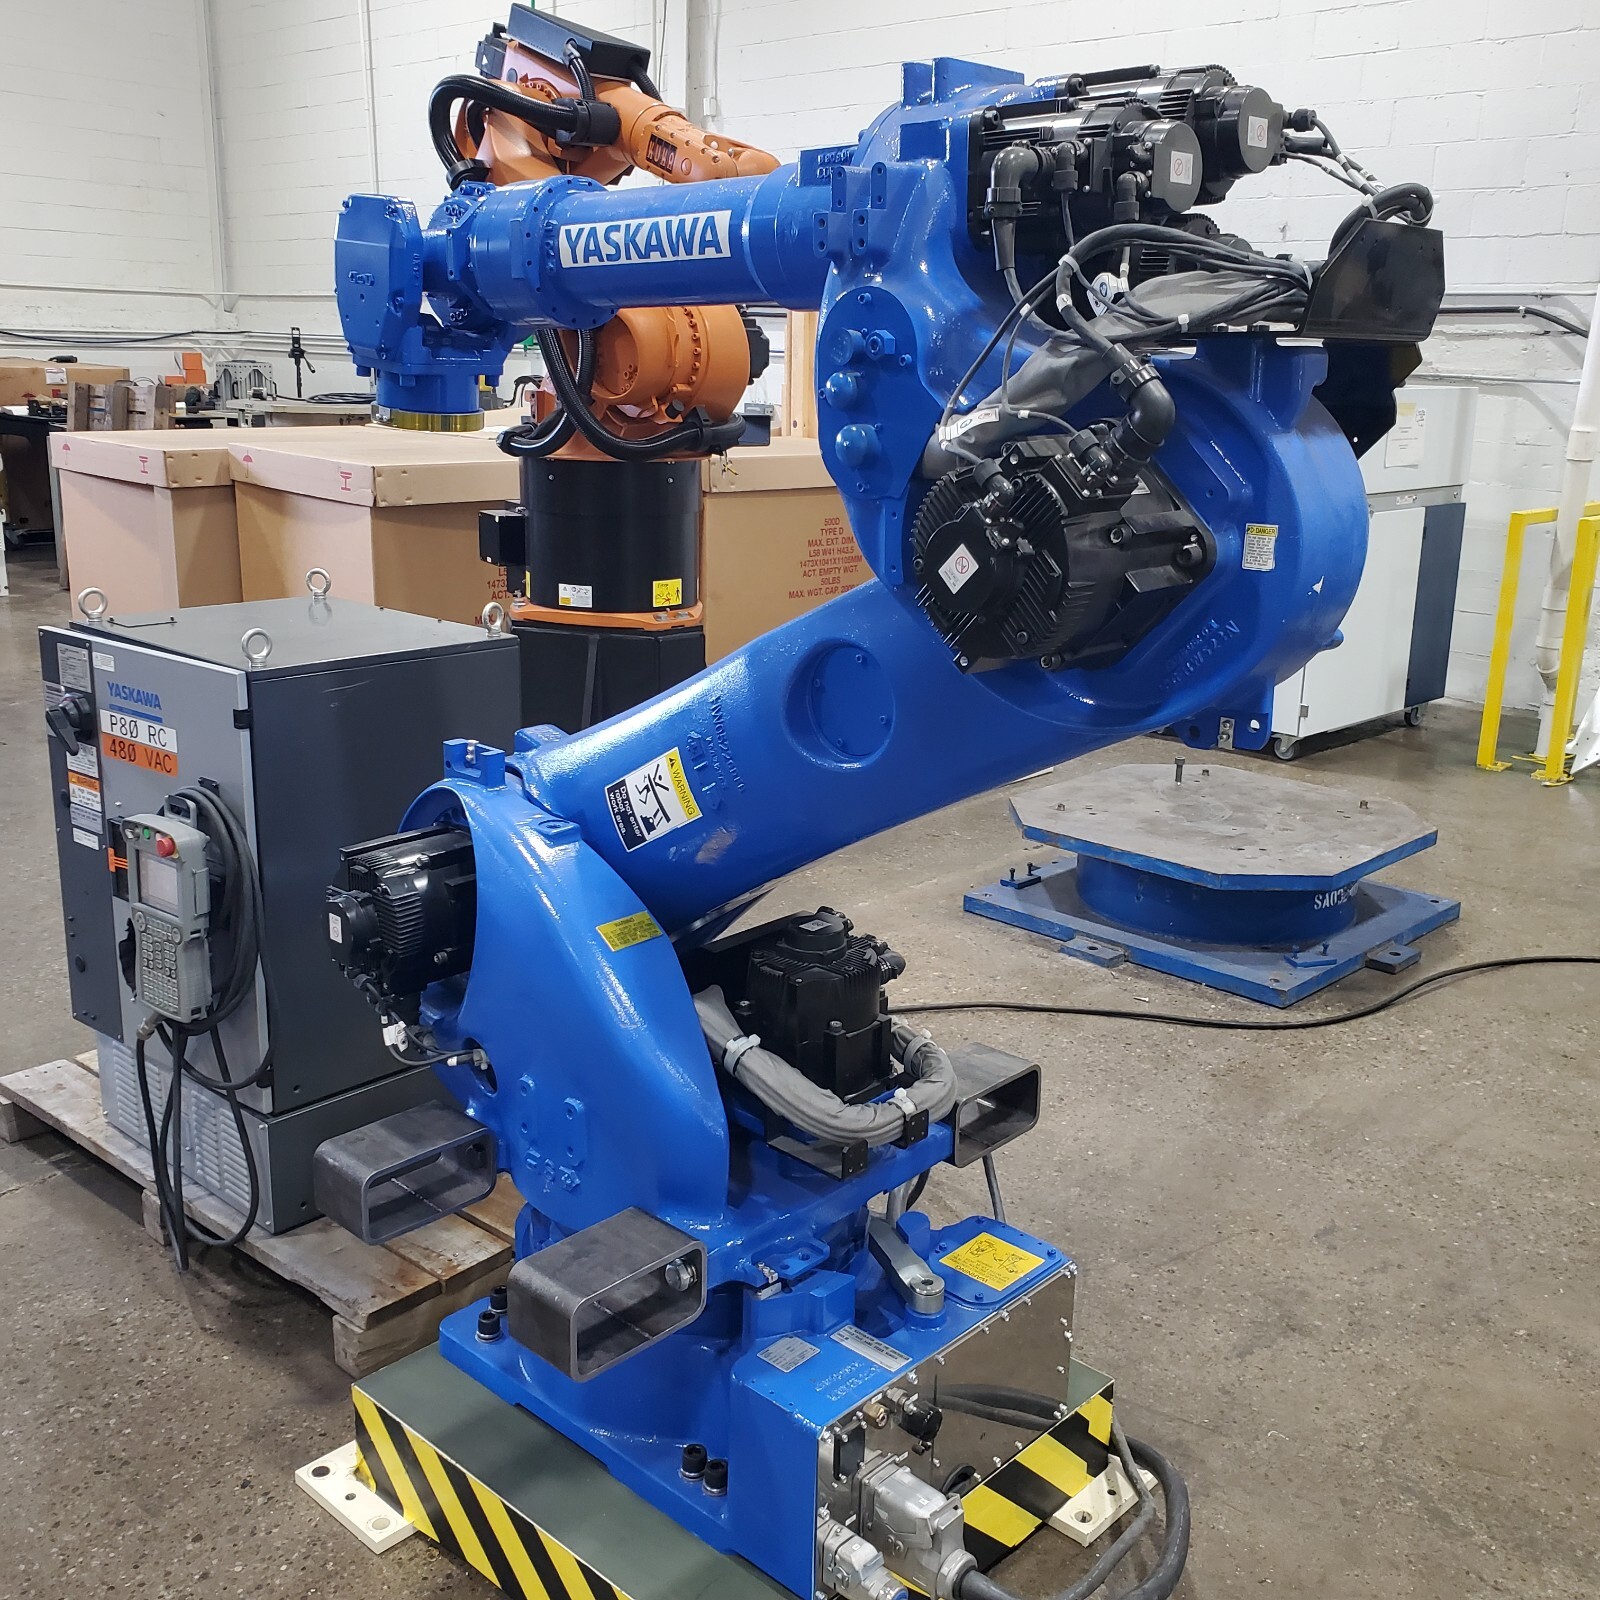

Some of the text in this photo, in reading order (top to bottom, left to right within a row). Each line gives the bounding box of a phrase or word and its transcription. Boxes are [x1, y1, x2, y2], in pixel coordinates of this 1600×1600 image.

[565, 216, 723, 264] YASKAWA
[820, 528, 837, 536] TYPE
[826, 538, 839, 546] EXT.
[822, 548, 834, 556] W41
[819, 567, 841, 576] EMPTY
[843, 565, 858, 573] WGT.
[821, 577, 840, 585] 50LBS
[492, 591, 509, 600] ACT.
[789, 591, 805, 599] MAX.
[808, 588, 823, 596] WGT.
[825, 587, 838, 595] CAP.
[107, 681, 162, 710] YASKAWA
[148, 725, 167, 747] RC
[145, 748, 172, 773] VAC
[615, 790, 625, 812] robot
[673, 769, 695, 815] WARNING
[610, 793, 626, 835] work area.
[621, 786, 642, 837] Do not enter
